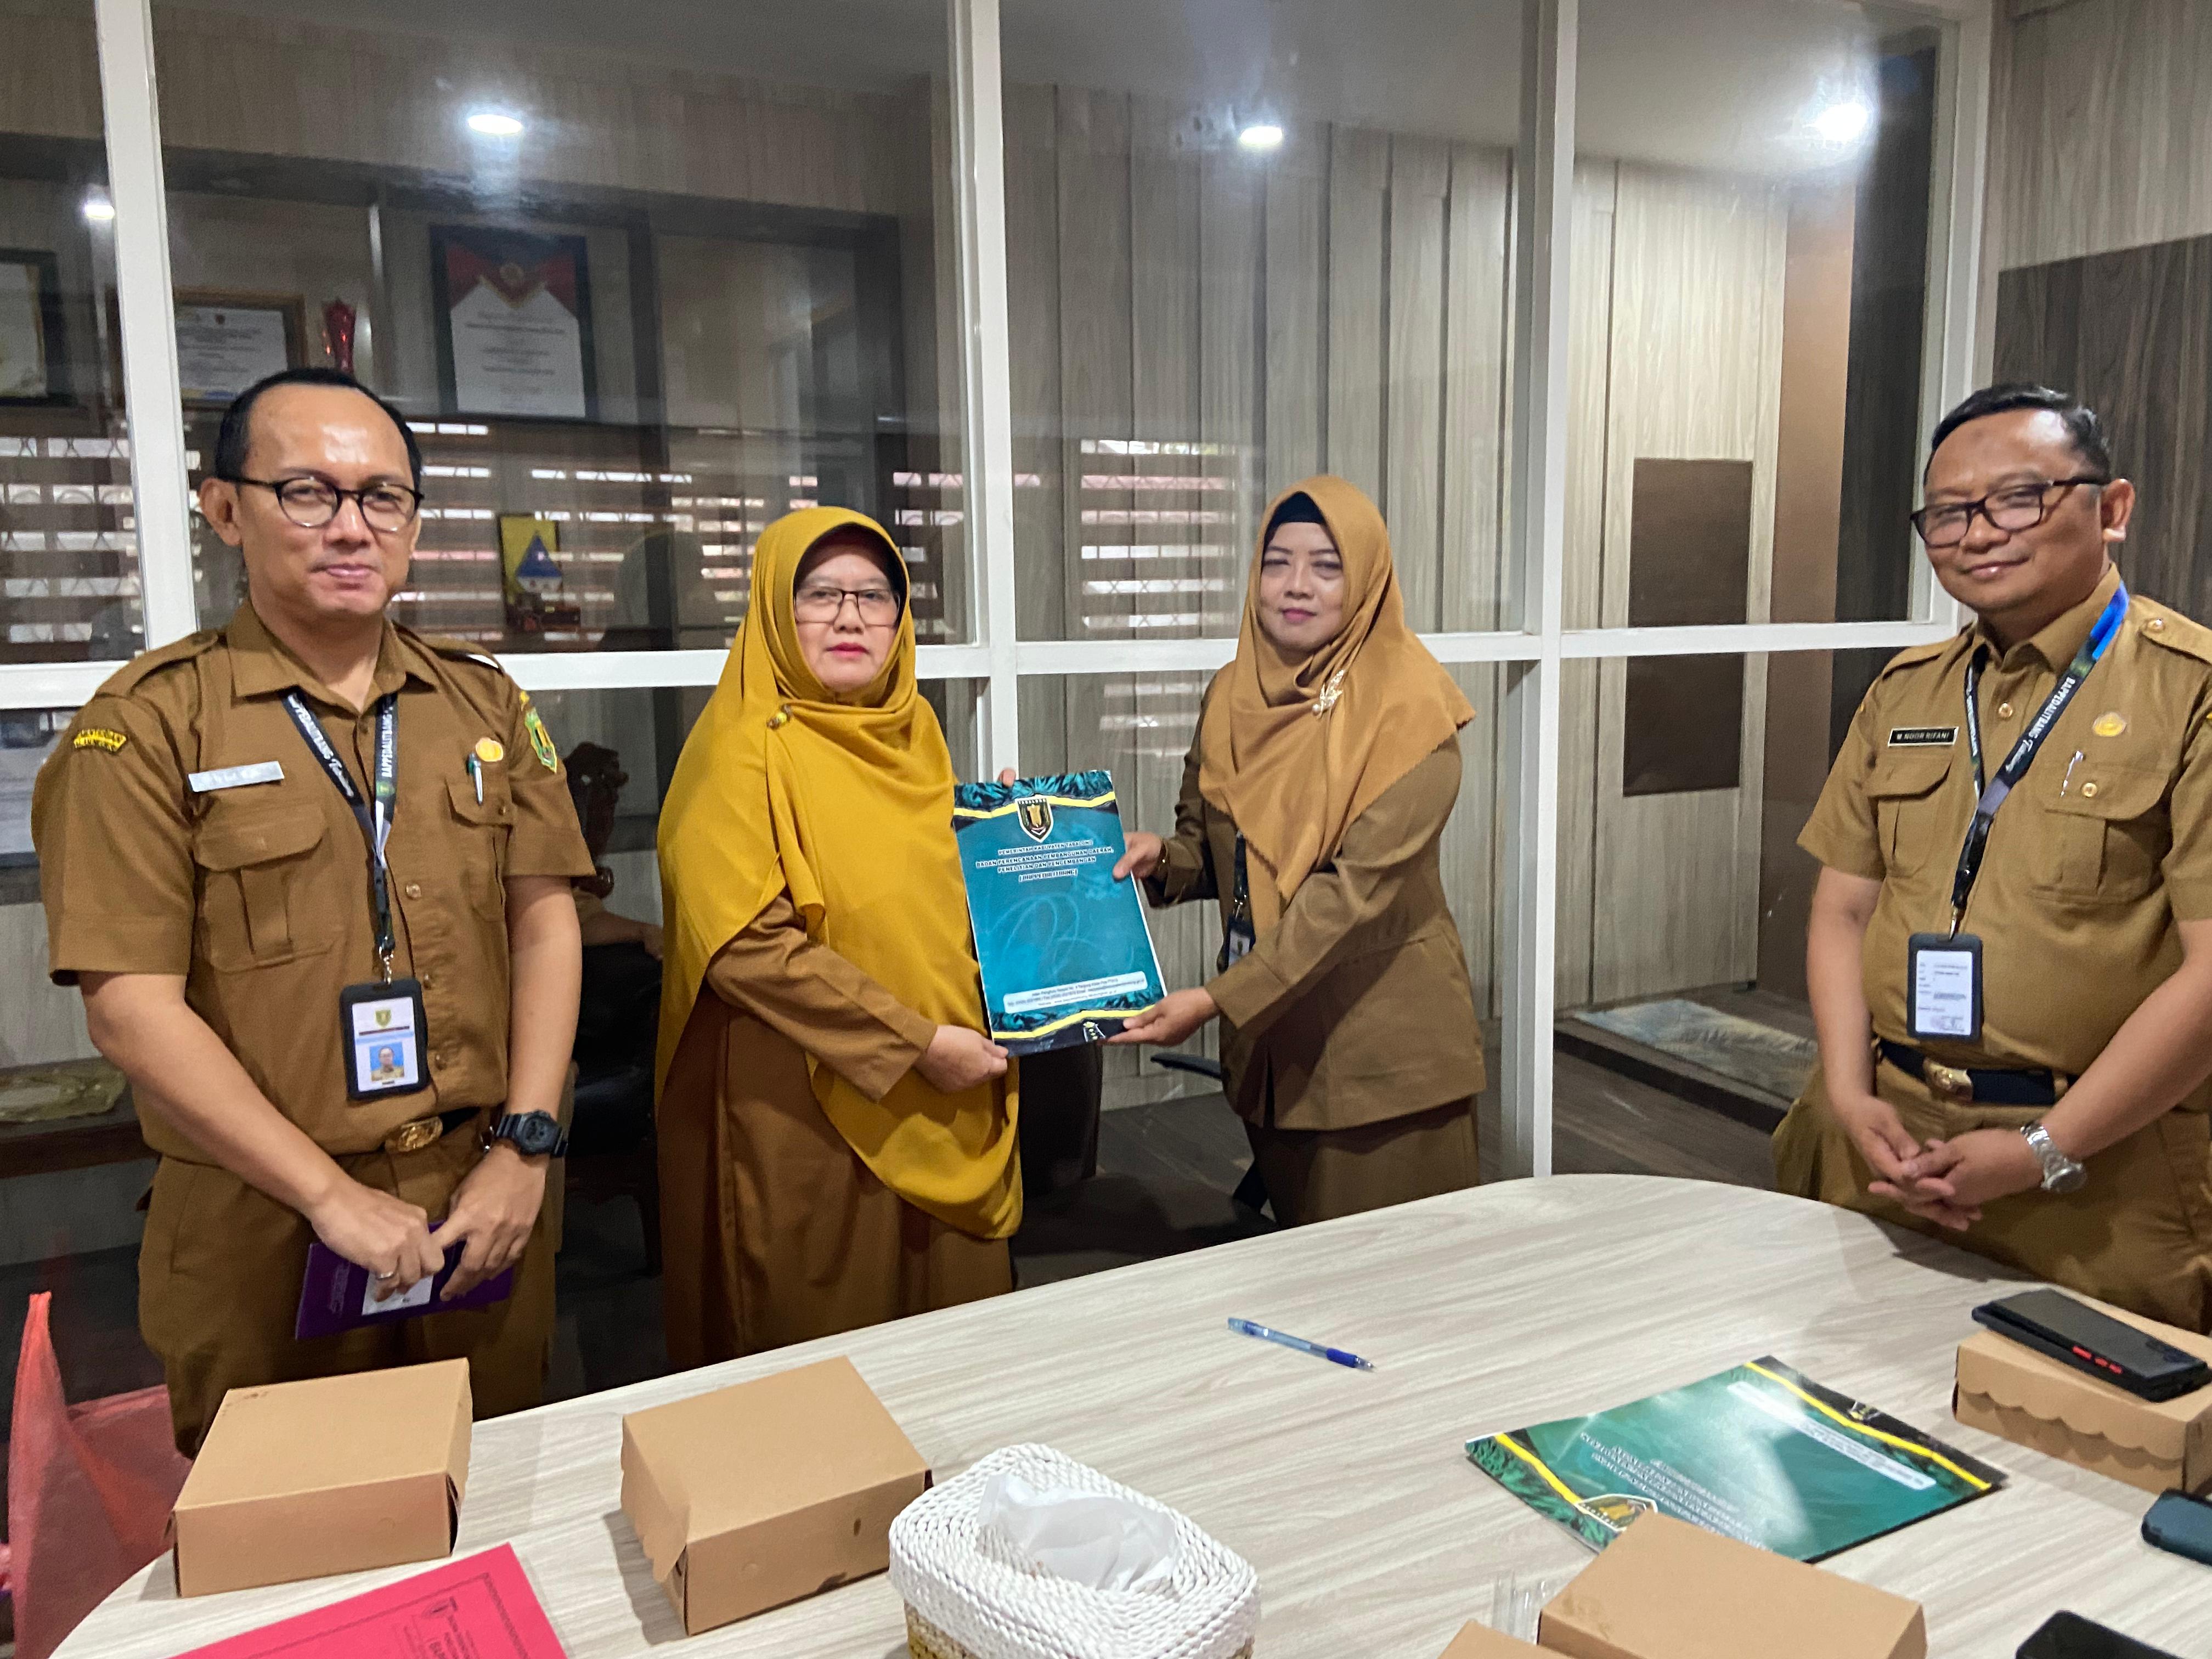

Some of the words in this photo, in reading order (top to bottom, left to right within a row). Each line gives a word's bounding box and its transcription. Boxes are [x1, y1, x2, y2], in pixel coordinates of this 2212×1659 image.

[976, 860, 997, 868] BADAN
[998, 855, 1042, 865] PERENCANAAN
[1043, 849, 1088, 859] PEMBANGUNAN
[998, 846, 1033, 855] PEMERINTAH
[997, 864, 1034, 873] PENELITIAN
[1048, 856, 1096, 866] PENGEMBANGAN
